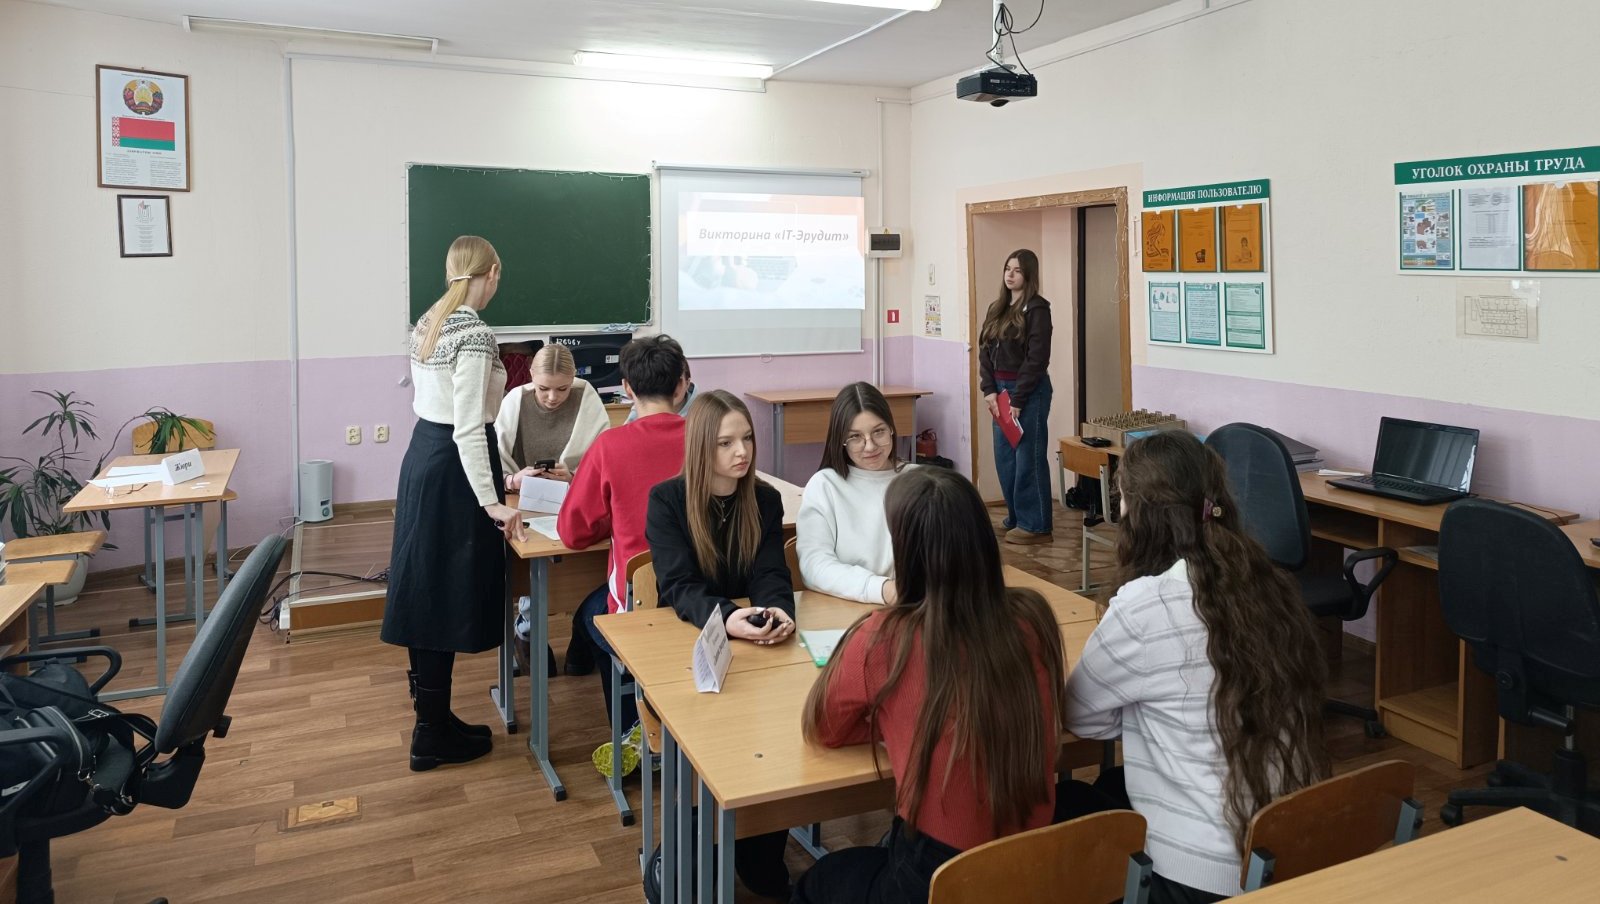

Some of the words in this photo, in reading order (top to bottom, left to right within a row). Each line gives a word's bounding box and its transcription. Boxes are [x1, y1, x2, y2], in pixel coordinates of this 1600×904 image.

[1412, 165, 1463, 180] УГОЛОК
[1467, 160, 1530, 175] ОХРАНЫ
[1534, 156, 1586, 171] ТРУДА
[1147, 190, 1196, 203] ИНФОРМАЦИЯ
[1197, 184, 1262, 199] ПОЛЬЗОВАТЕЛЮ
[699, 228, 771, 242] Викторина
[774, 229, 849, 243] «IT-Эрудит»
[174, 461, 192, 471] Жюри
